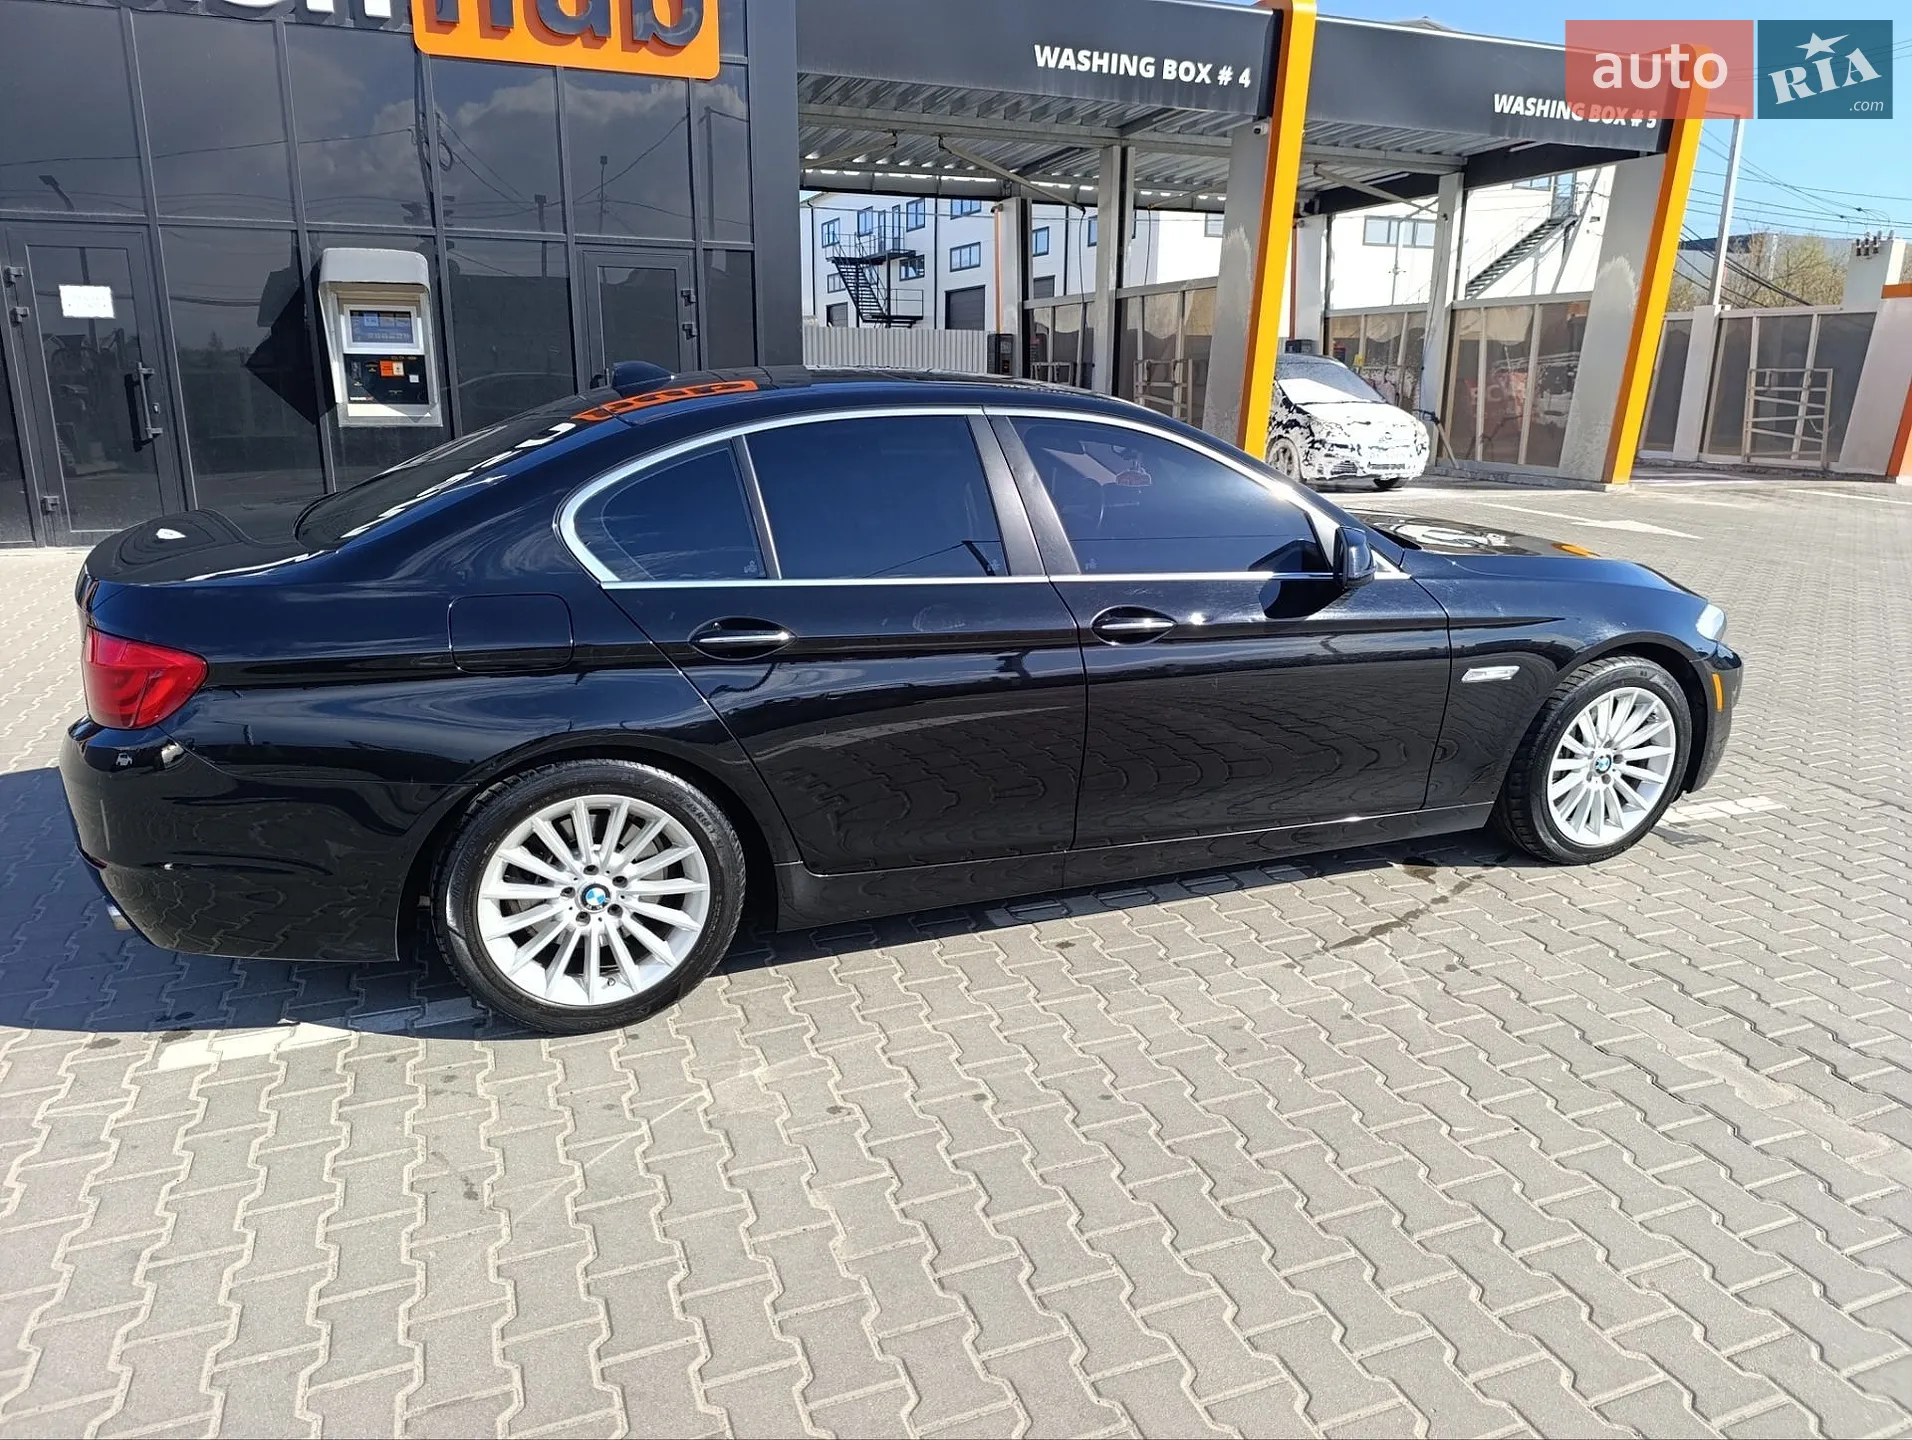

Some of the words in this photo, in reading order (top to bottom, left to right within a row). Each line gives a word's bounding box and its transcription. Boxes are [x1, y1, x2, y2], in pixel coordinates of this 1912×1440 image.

[1034, 44, 1156, 79] WASHING
[1163, 59, 1212, 84] BOX
[1238, 67, 1251, 88] 4
[1494, 93, 1584, 122] WASHING
[1588, 104, 1627, 126] BOX
[1646, 110, 1658, 129] 5
